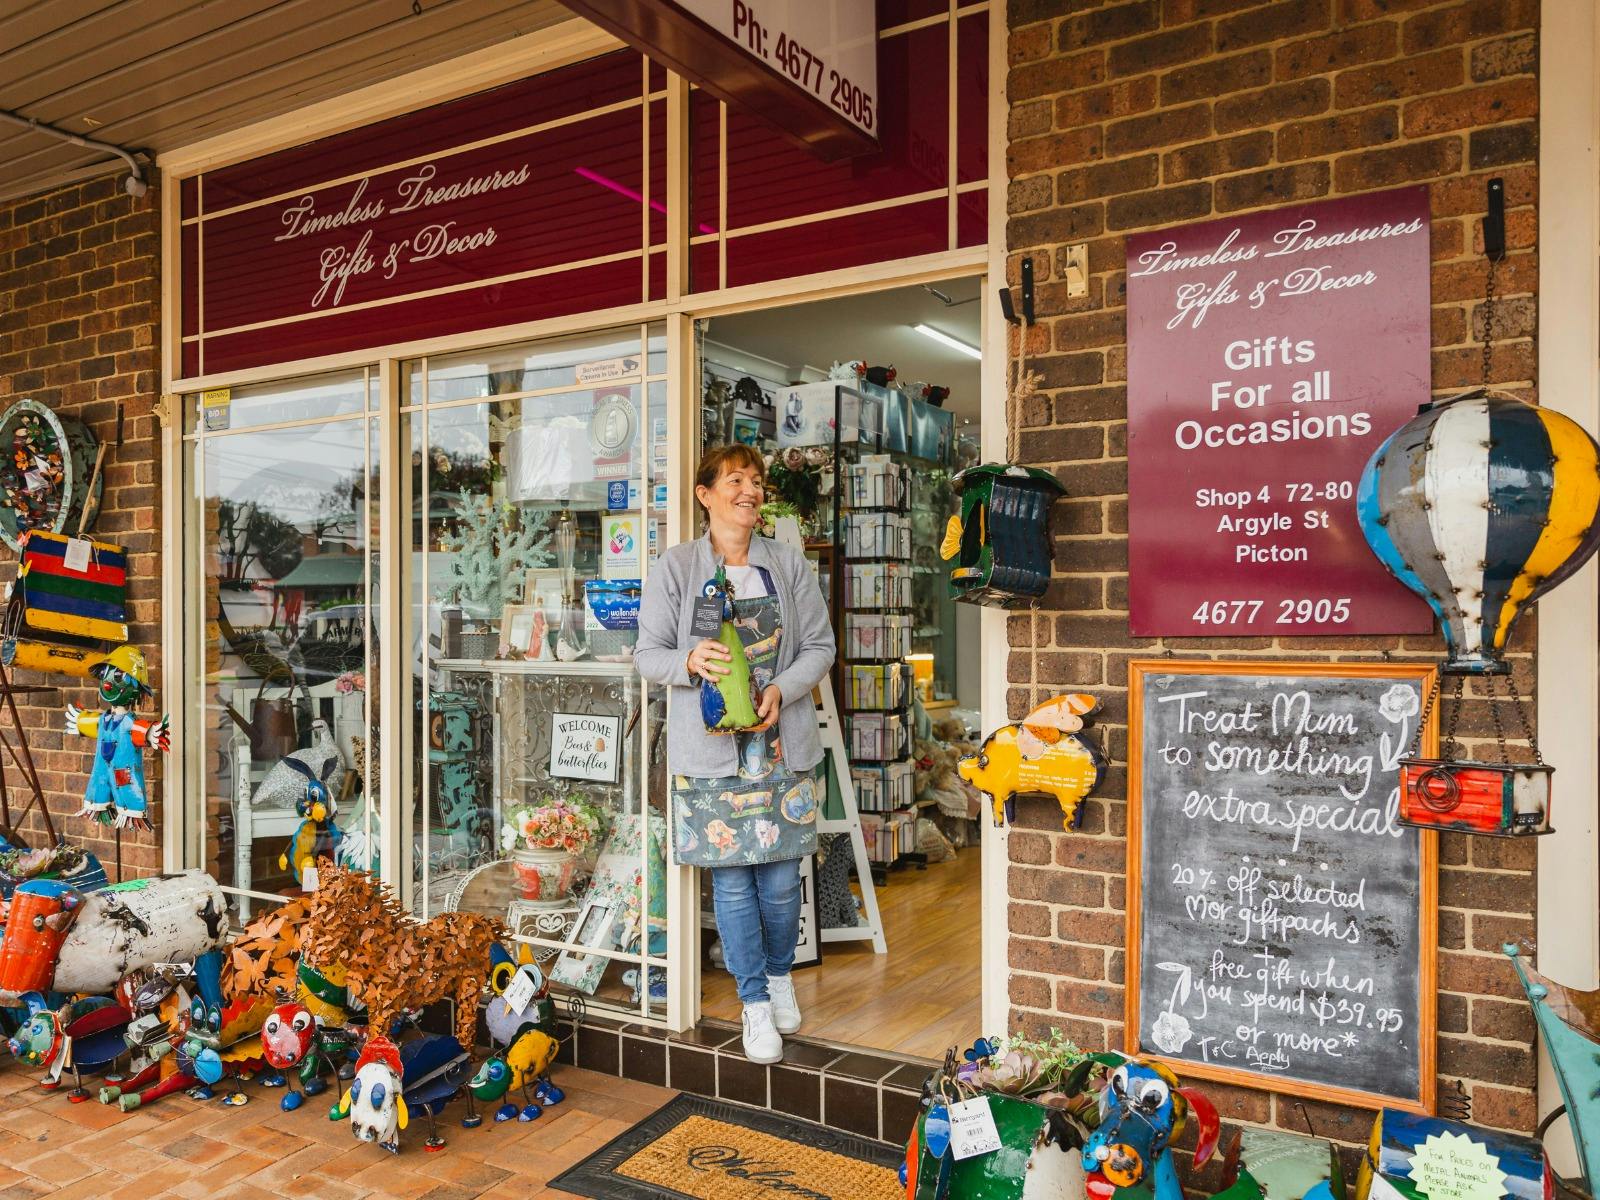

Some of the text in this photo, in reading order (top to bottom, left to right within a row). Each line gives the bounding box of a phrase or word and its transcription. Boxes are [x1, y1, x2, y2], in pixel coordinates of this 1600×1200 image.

[733, 0, 873, 130] Ph: 4677 2905
[274, 164, 531, 242] Timeless Treasures
[311, 221, 498, 307] Gifts & Decor
[1130, 217, 1423, 277] Timeless Treasures
[1166, 265, 1377, 329] Gifts & Decor
[1224, 336, 1315, 371] Gifts
[1211, 371, 1331, 411] For all
[1175, 410, 1372, 450] Occasions
[597, 465, 627, 476] WINNER
[1195, 480, 1353, 509] Shop 4 72-80
[1216, 509, 1329, 536] Argyle St
[1236, 544, 1308, 563] Picton
[1192, 598, 1351, 624] 4677 2905
[558, 720, 612, 738] WELCOME
[1158, 691, 1358, 735] Treat Mum
[557, 750, 608, 775] butterflies
[584, 740, 592, 751] &
[1158, 736, 1373, 800] to something
[1182, 786, 1404, 852] extra special
[1171, 863, 1365, 911] 20% off selected
[1209, 950, 1374, 996] free gift when
[1193, 978, 1403, 1032] you spend $39.95
[1236, 1025, 1265, 1044] or
[1246, 1046, 1290, 1069] Apply
